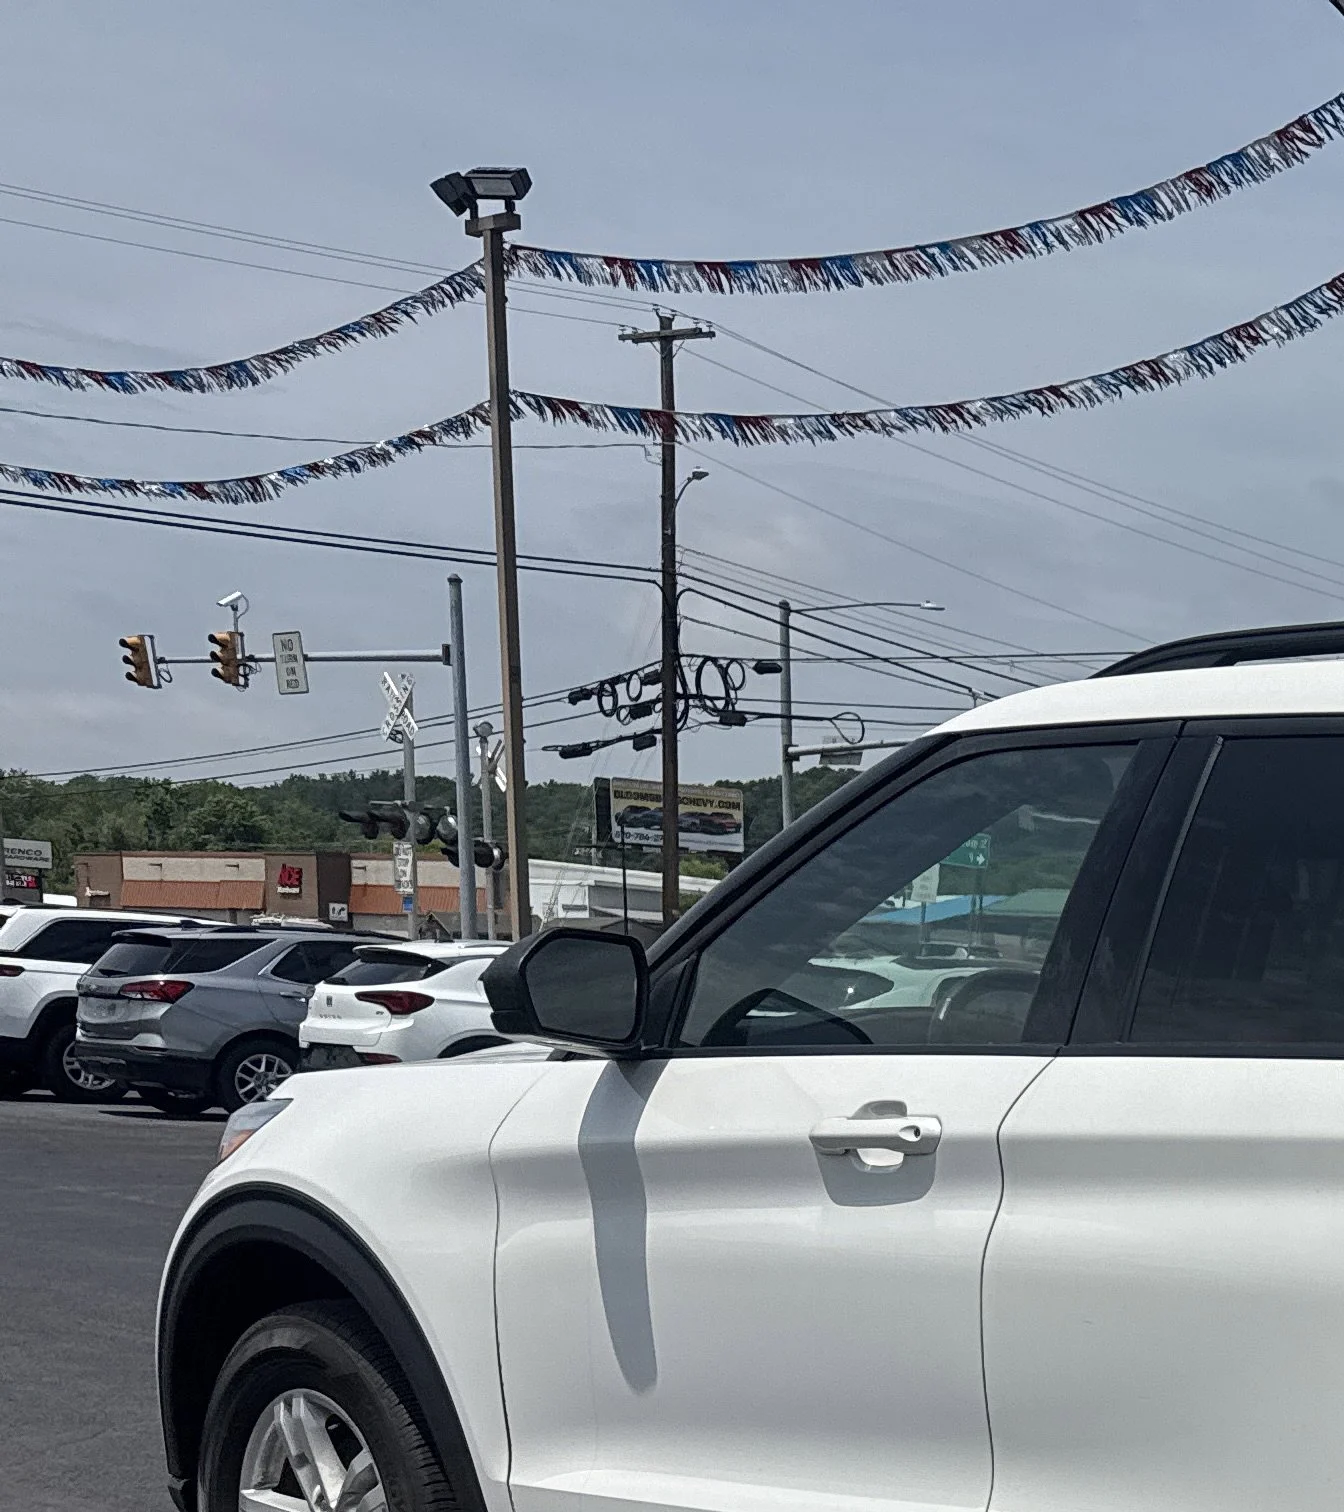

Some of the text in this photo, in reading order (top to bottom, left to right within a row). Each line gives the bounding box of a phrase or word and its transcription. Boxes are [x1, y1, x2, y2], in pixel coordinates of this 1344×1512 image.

[280, 638, 294, 652] NO
[279, 653, 298, 664] TURN
[285, 666, 297, 677] ON
[286, 678, 300, 690] RED
[277, 864, 303, 887] ACE
